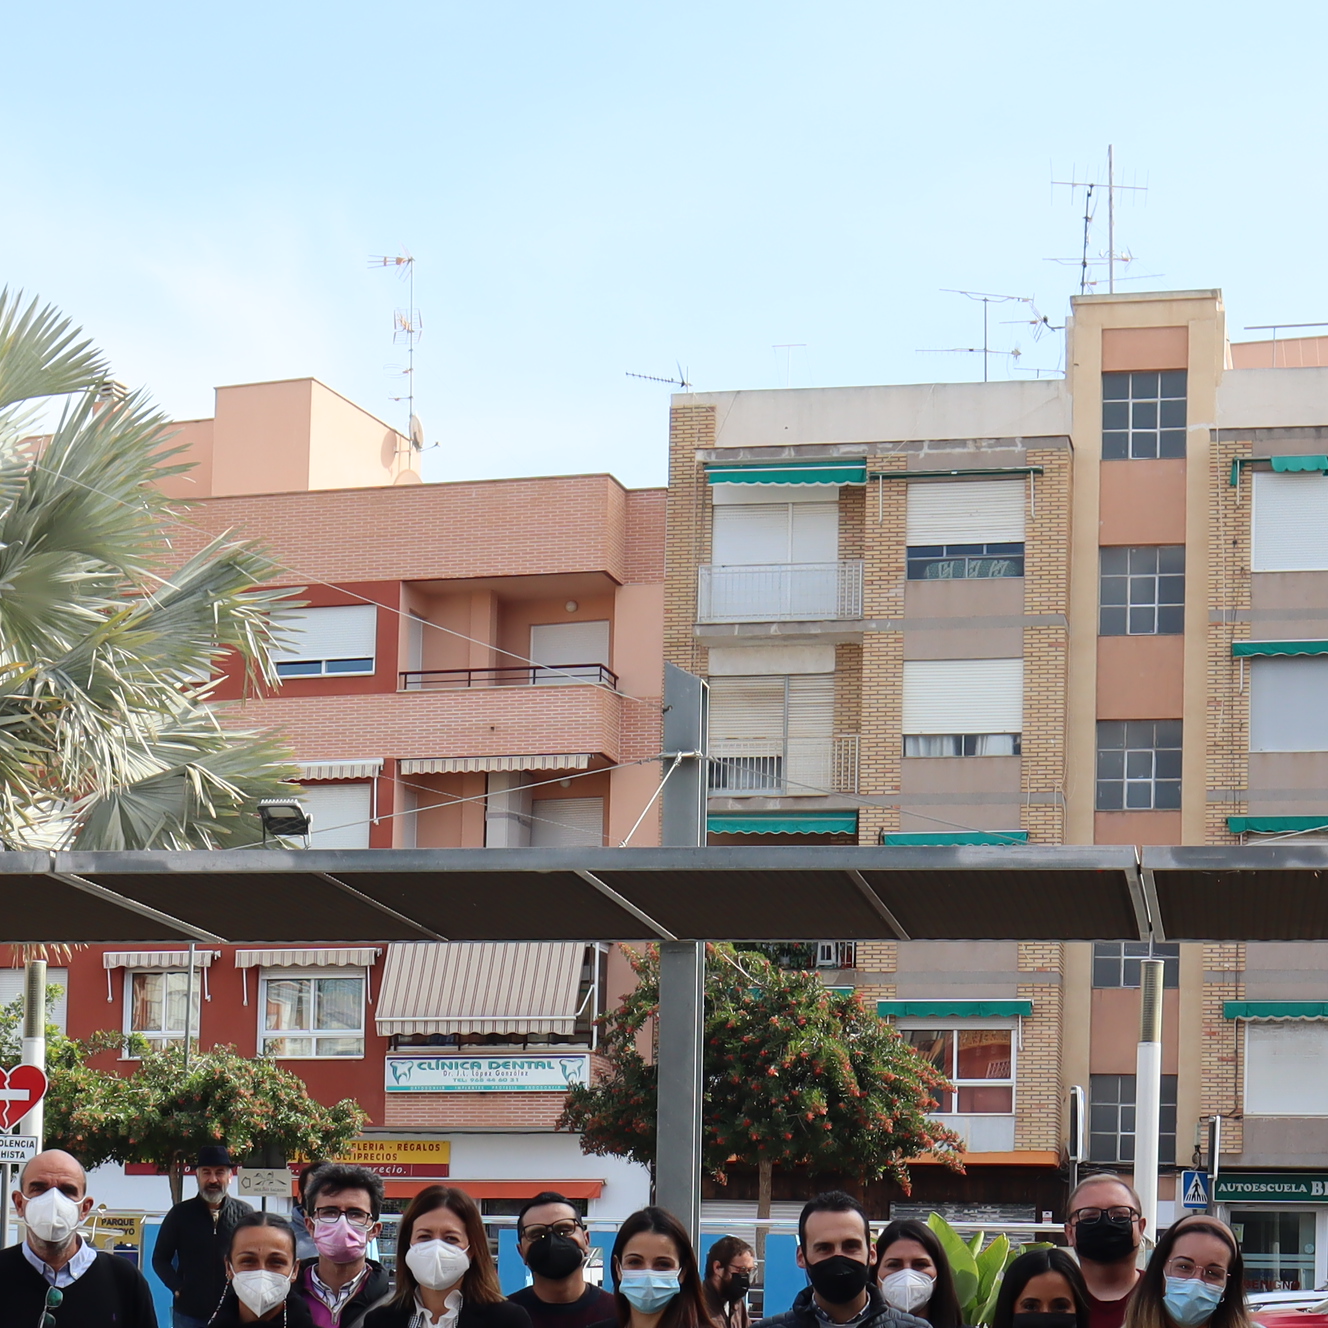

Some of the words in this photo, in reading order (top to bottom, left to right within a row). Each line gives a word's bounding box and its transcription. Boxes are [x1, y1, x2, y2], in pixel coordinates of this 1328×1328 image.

[417, 1060, 481, 1070] CLÍNICA
[488, 1060, 554, 1070] DENTAL
[397, 1143, 441, 1151] REGALOS
[1218, 1183, 1308, 1193] AUTOESCUELA
[102, 1218, 135, 1226] PARQUE
